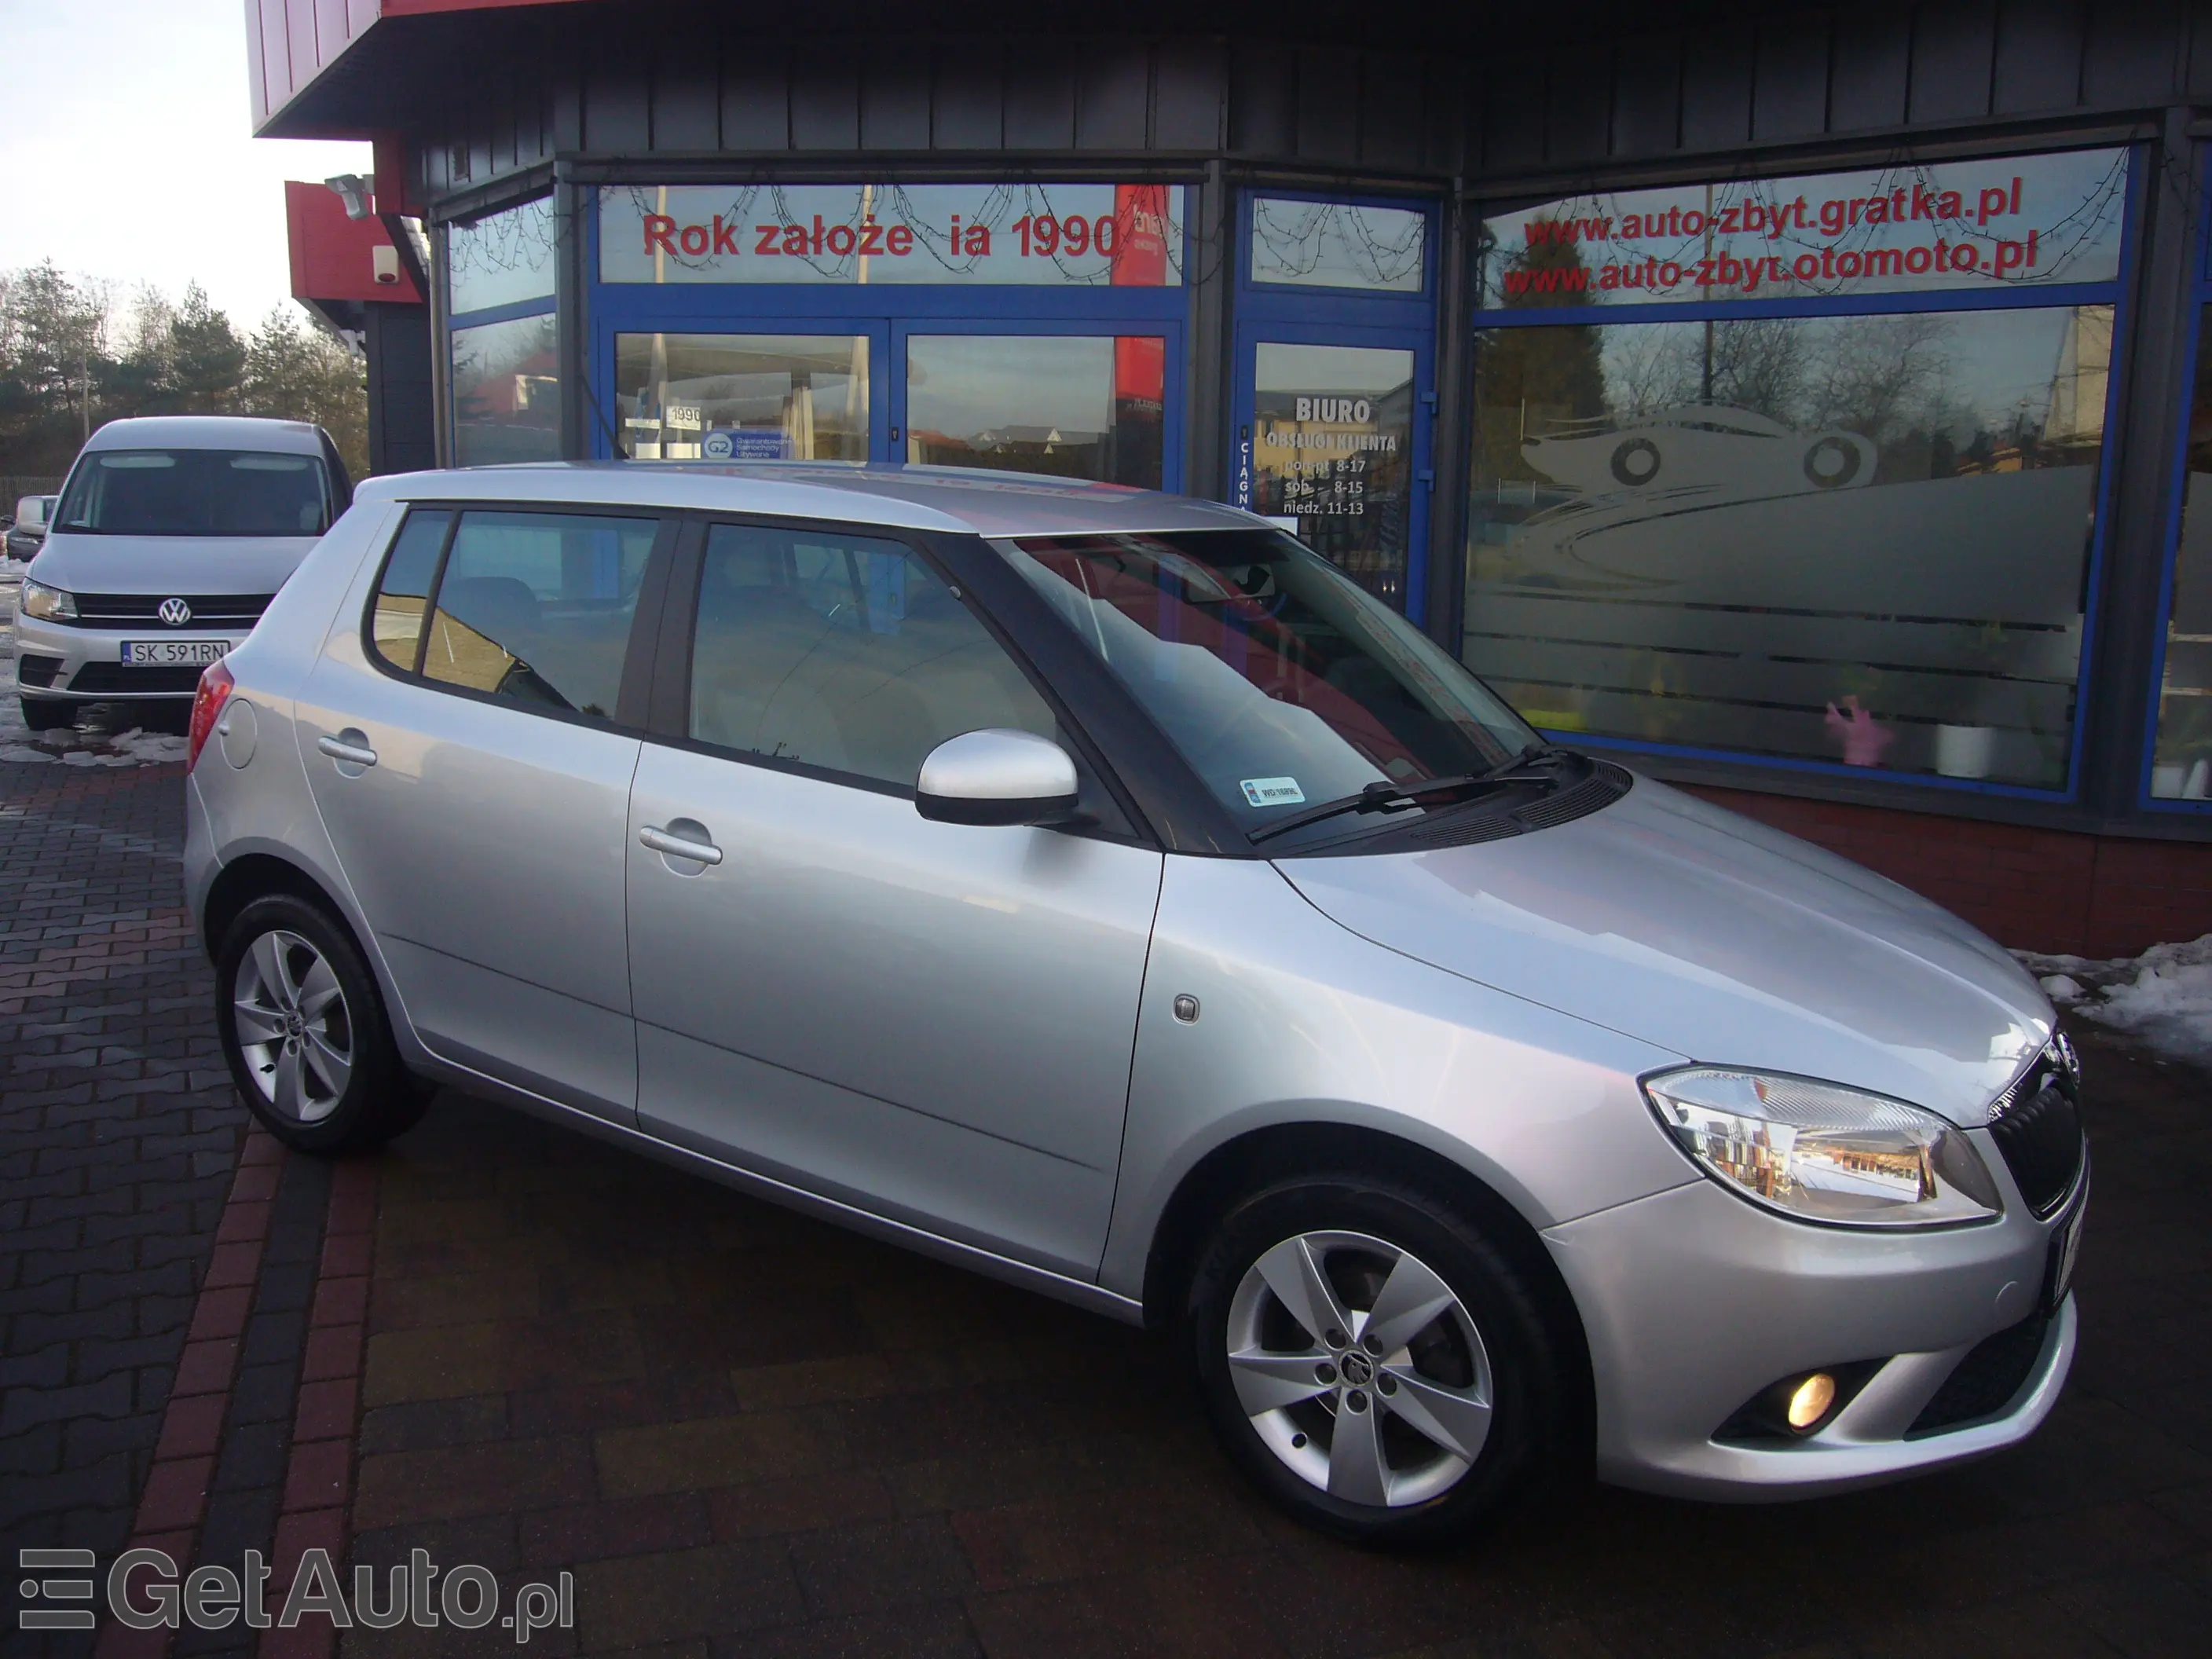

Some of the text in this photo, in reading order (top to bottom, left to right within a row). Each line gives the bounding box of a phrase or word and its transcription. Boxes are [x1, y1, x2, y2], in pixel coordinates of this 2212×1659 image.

[1523, 175, 2023, 248] www.auto-zbyt.gratka.pl
[643, 214, 740, 256] Rok
[1012, 214, 1119, 257] 1990
[672, 408, 701, 422] 1990
[1296, 397, 1371, 424] BIURO
[708, 440, 729, 453] G2
[1337, 434, 1396, 452] KLIENTA
[1336, 460, 1366, 472] 8-17
[1334, 482, 1364, 494] 8-15
[1283, 500, 1364, 515] niedz. 11-13
[135, 643, 224, 661] SK 591RN
